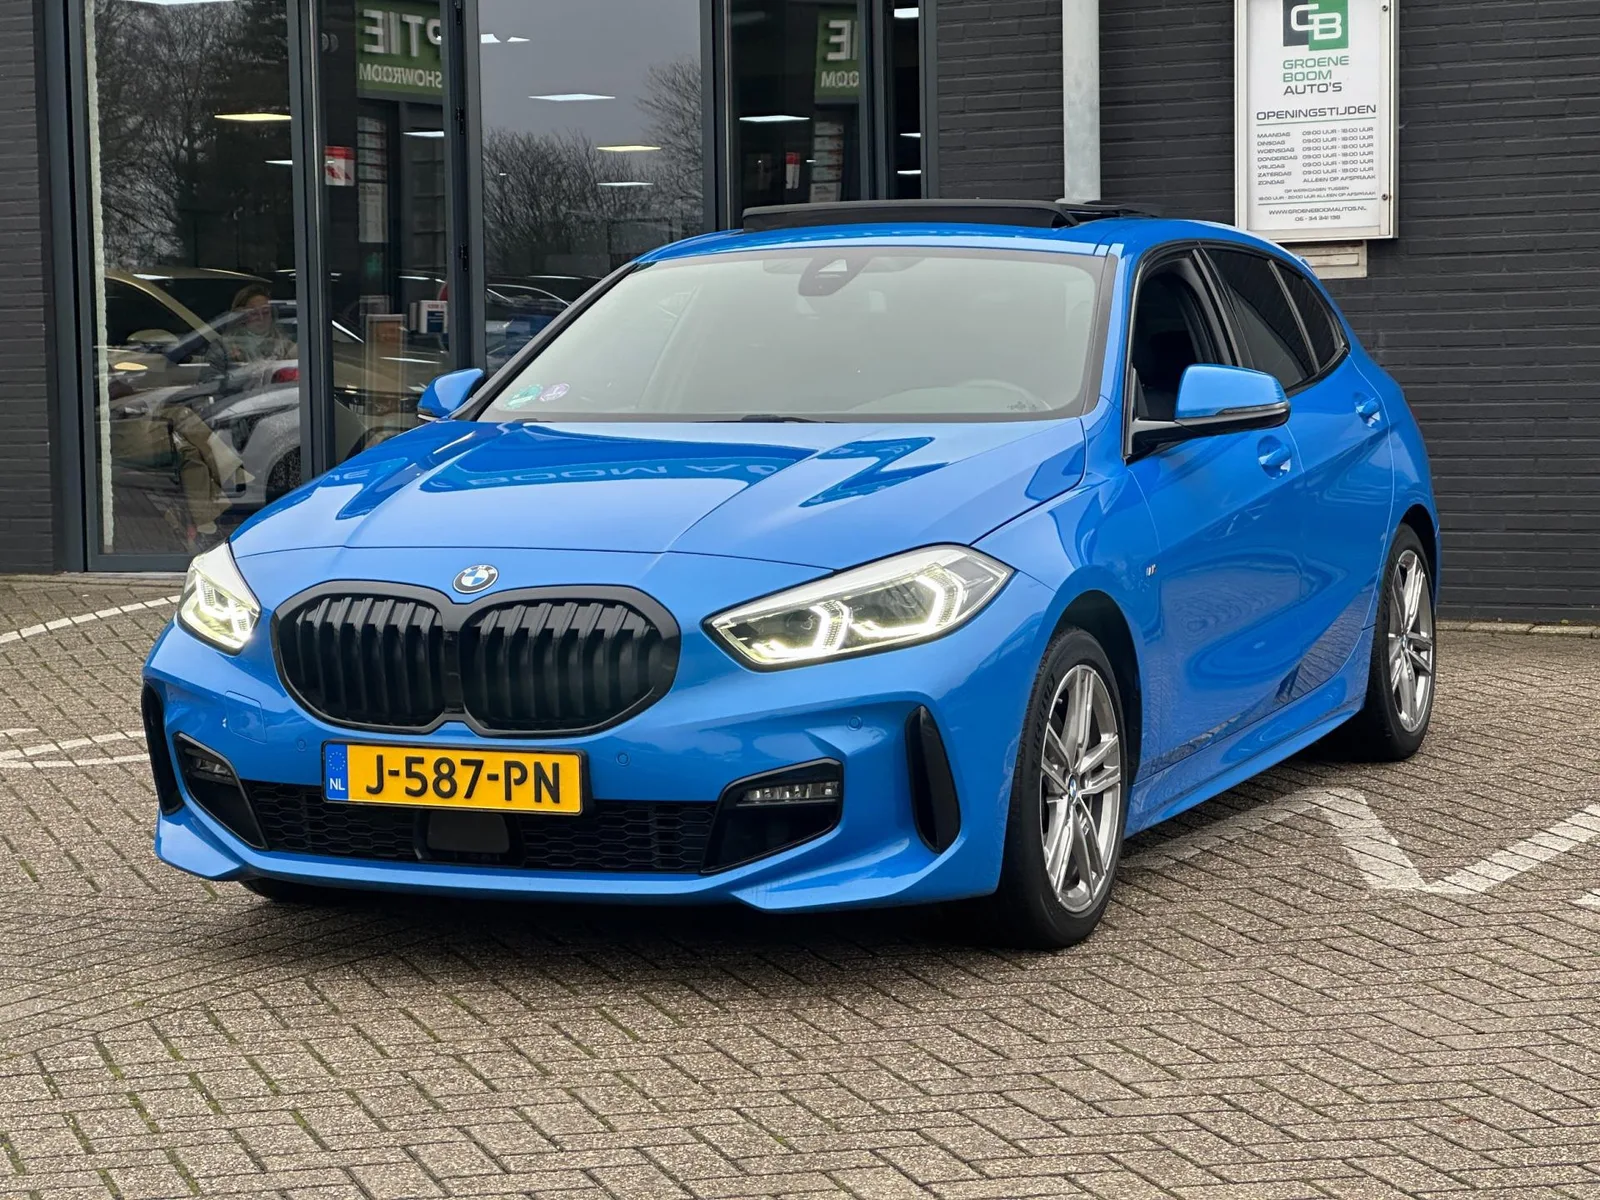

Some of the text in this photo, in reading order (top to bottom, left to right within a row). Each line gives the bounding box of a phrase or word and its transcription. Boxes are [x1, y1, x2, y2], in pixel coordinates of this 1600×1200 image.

[1283, 55, 1349, 70] GROENE
[1283, 70, 1332, 82] BOOM
[1283, 82, 1343, 96] AUTO'S
[1256, 104, 1376, 120] OPENINGSTIJDEN
[329, 777, 346, 791] NL
[366, 754, 561, 804] J-587-PN
